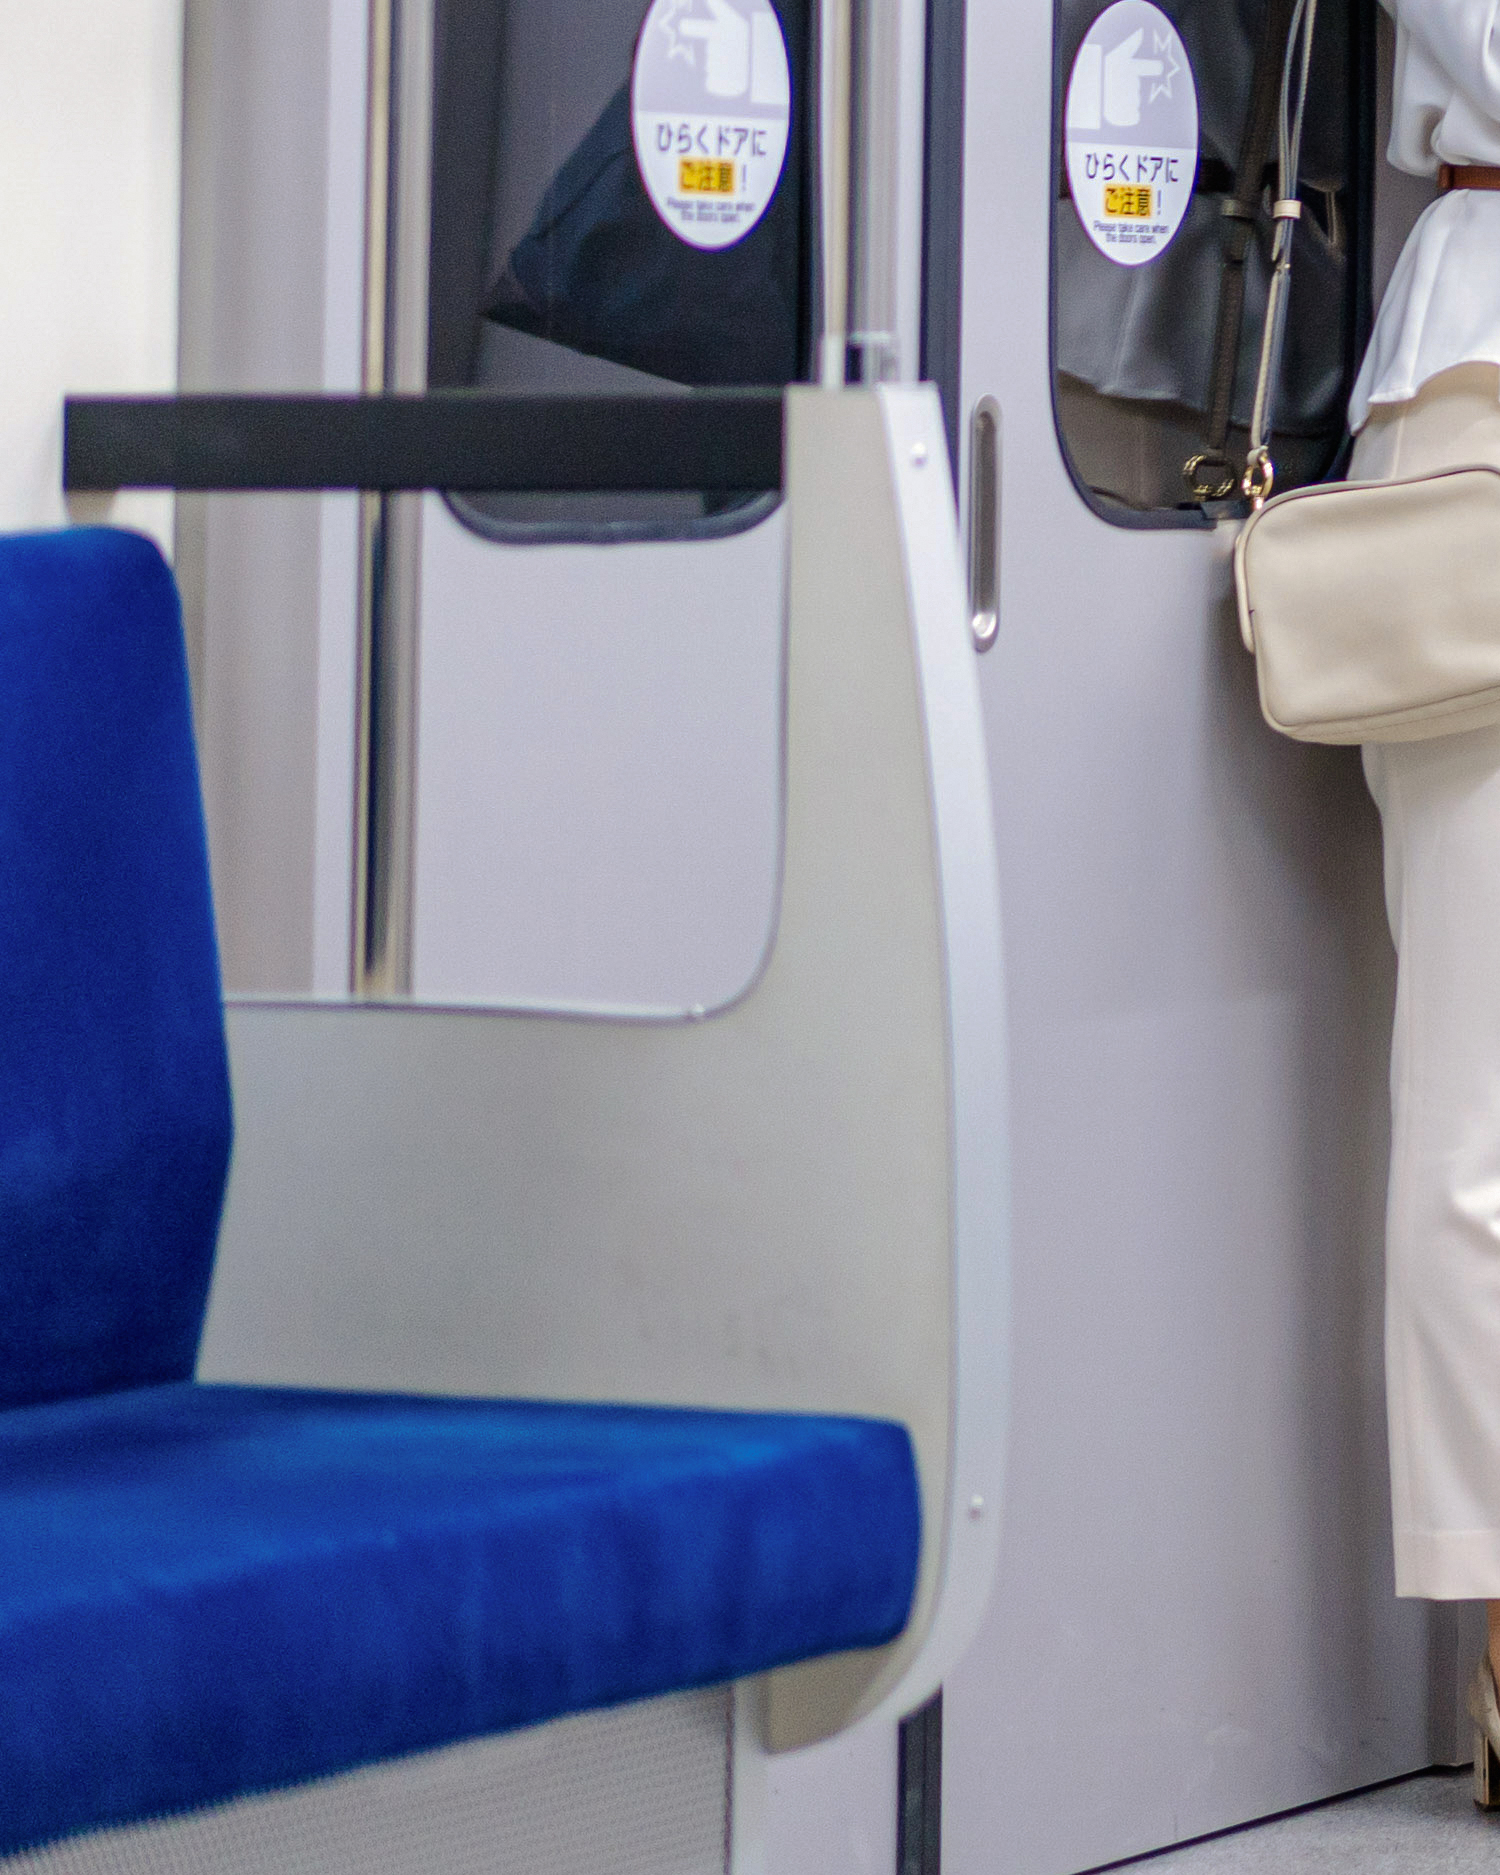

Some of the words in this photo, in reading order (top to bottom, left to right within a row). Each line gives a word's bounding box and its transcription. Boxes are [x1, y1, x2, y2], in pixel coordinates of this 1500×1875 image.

[657, 123, 767, 156] ひらくドアに
[1086, 153, 1179, 183] ひらくドアに
